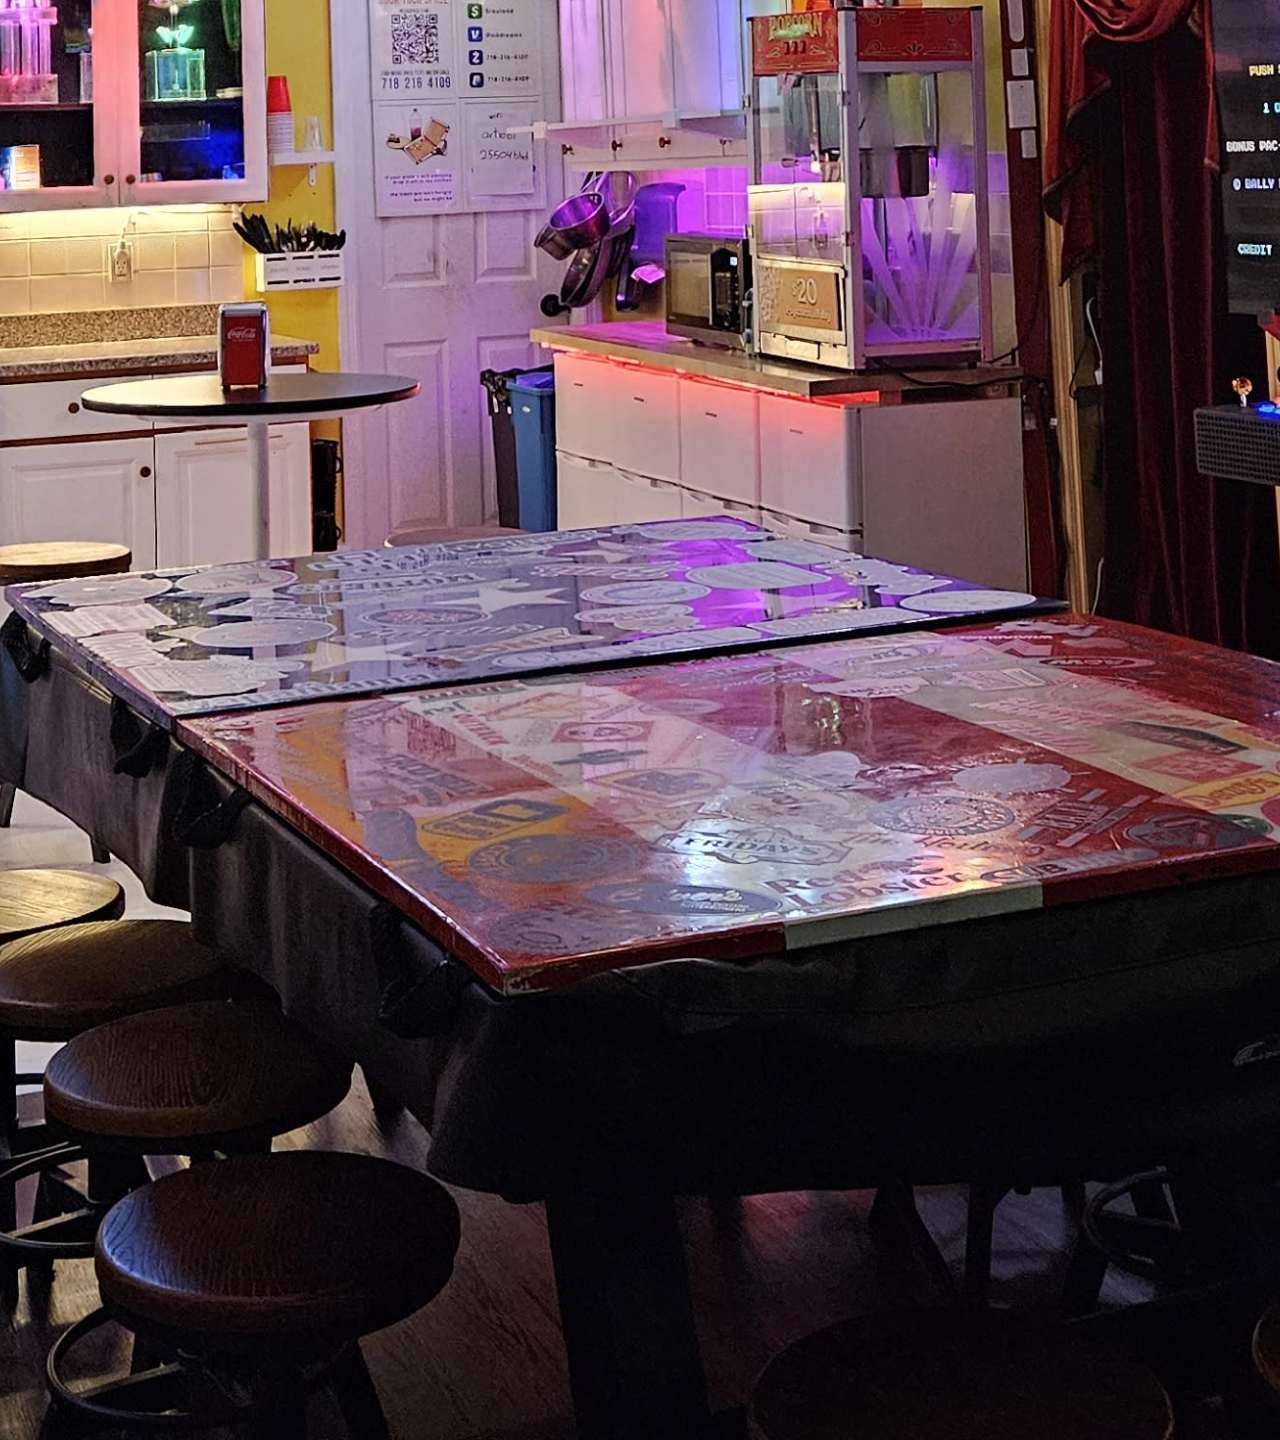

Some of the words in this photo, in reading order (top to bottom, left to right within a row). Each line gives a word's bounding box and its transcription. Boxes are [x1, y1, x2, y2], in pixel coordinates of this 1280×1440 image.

[769, 13, 823, 41] POPCORN
[1249, 65, 1274, 76] PUSH
[382, 78, 400, 90] 718
[404, 77, 423, 89] 216
[427, 76, 451, 89] 4109
[1263, 102, 1270, 113] 1
[1226, 140, 1255, 152] BONUS
[1245, 178, 1275, 189] BALLY
[1237, 243, 1272, 255] CREDIT
[1183, 777, 1280, 807] Denny's
[684, 837, 818, 857] FRIDAYS
[764, 868, 864, 895] Red
[784, 871, 965, 909] Lobster
